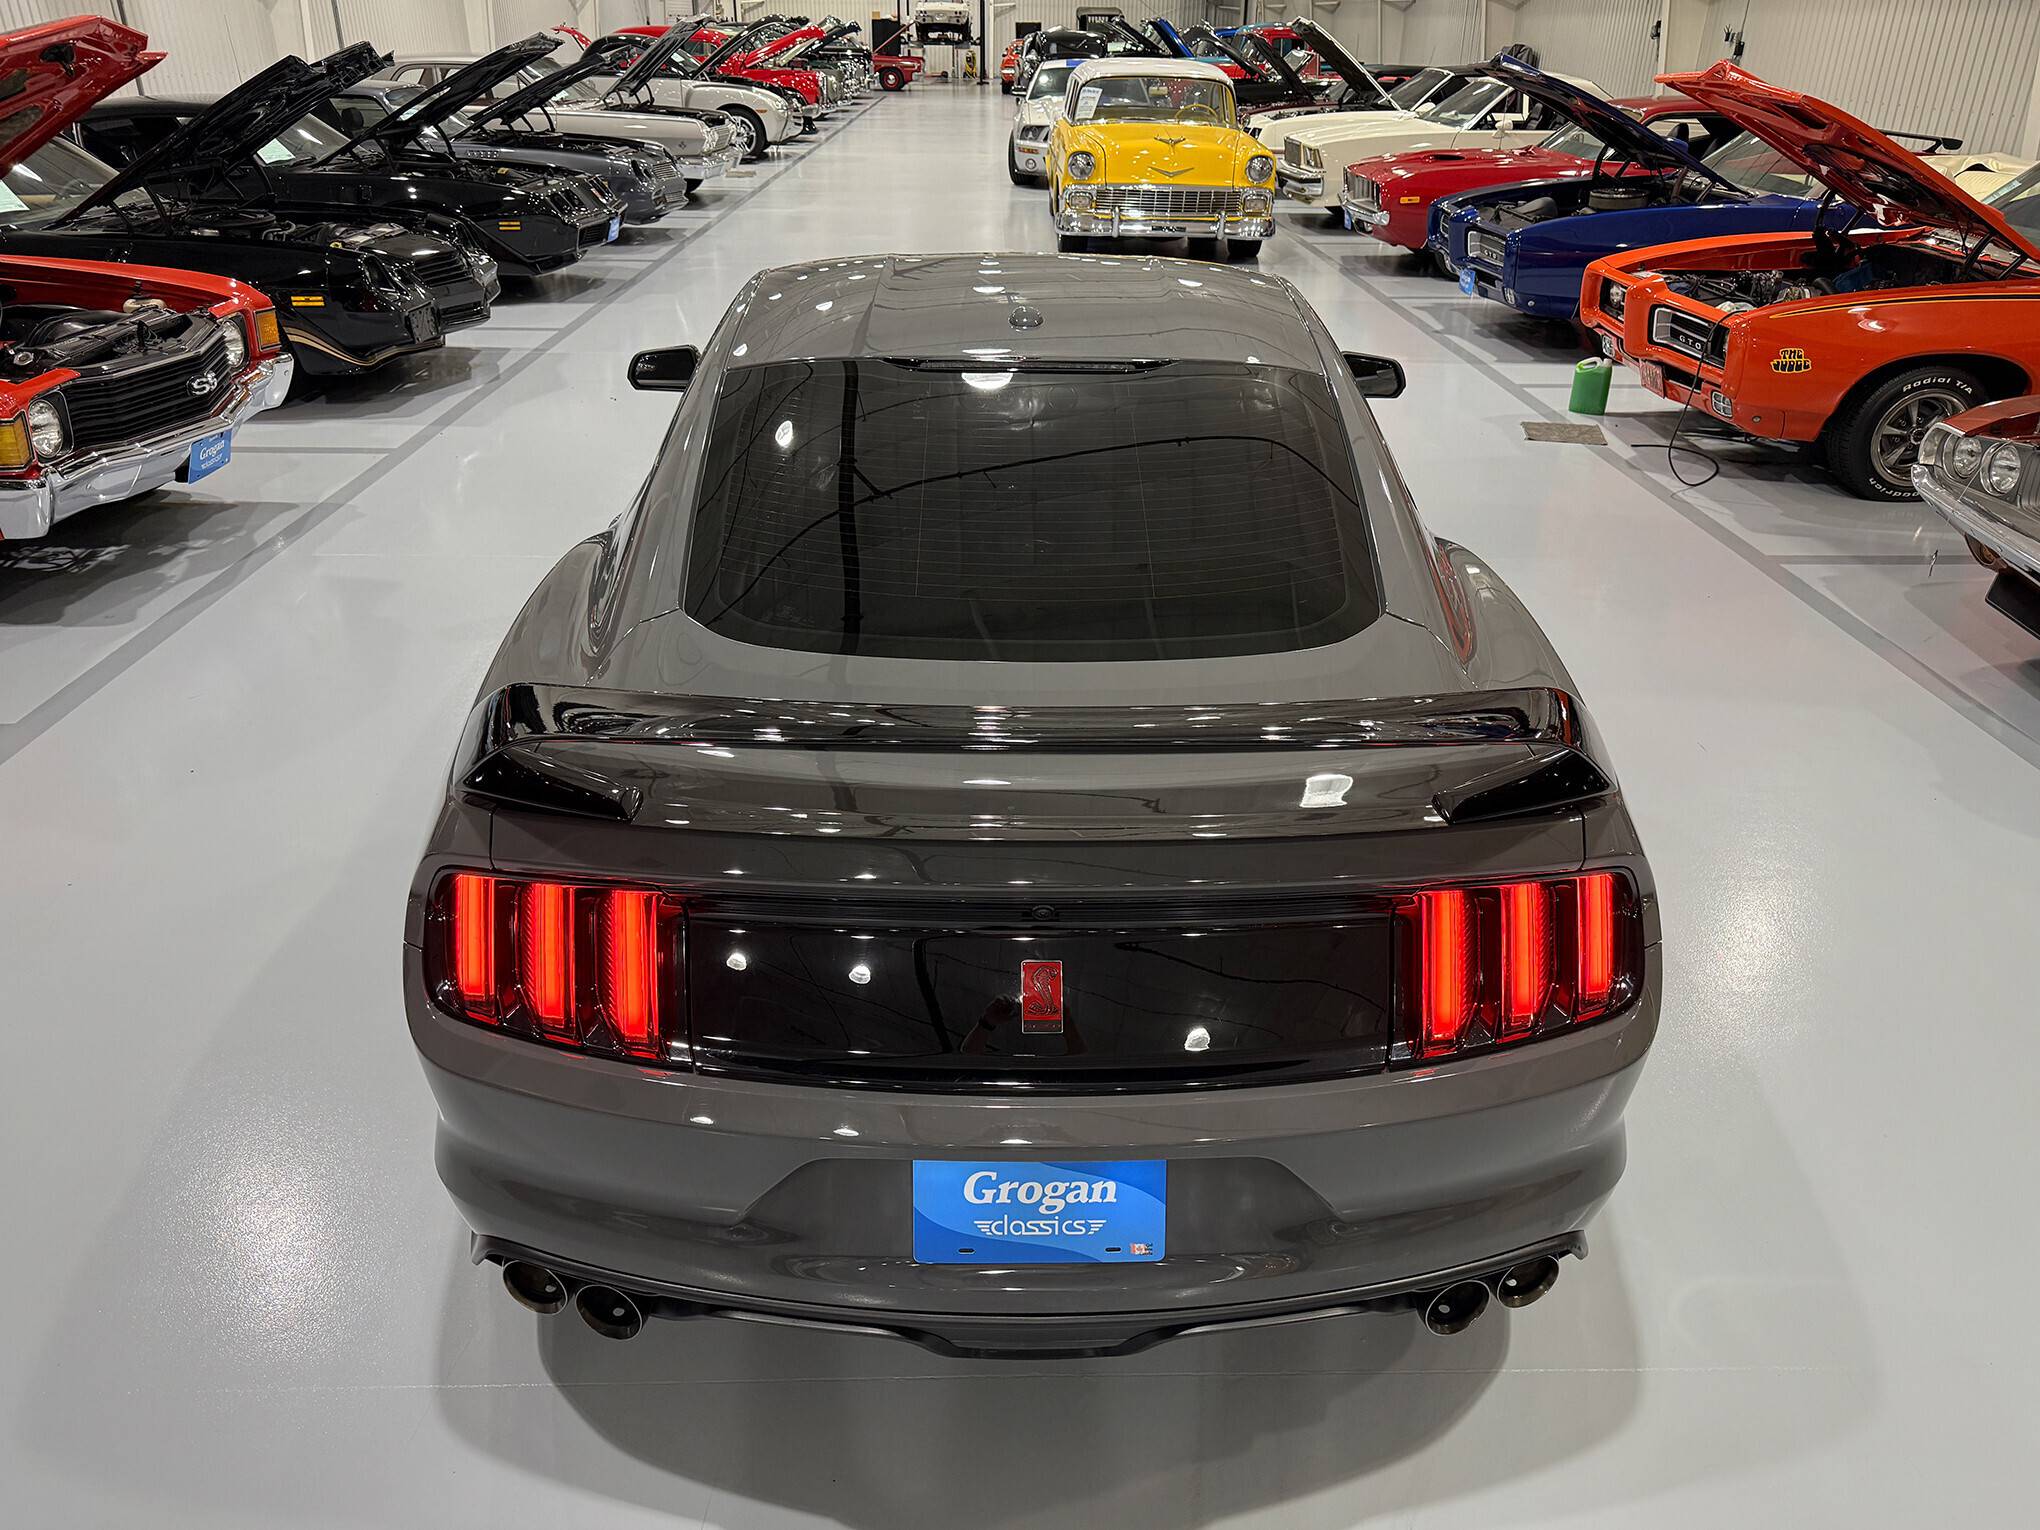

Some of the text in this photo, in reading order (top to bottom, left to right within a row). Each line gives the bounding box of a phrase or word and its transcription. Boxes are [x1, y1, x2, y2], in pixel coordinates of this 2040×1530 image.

[1780, 348, 1804, 360] THE
[1771, 359, 1811, 373] JUDGE
[1902, 376, 1973, 395] Radial T/A
[200, 439, 225, 460] Grogan
[1868, 477, 1920, 498] oodrich
[963, 1171, 1117, 1214] Grogan
[991, 1214, 1087, 1236] classics
